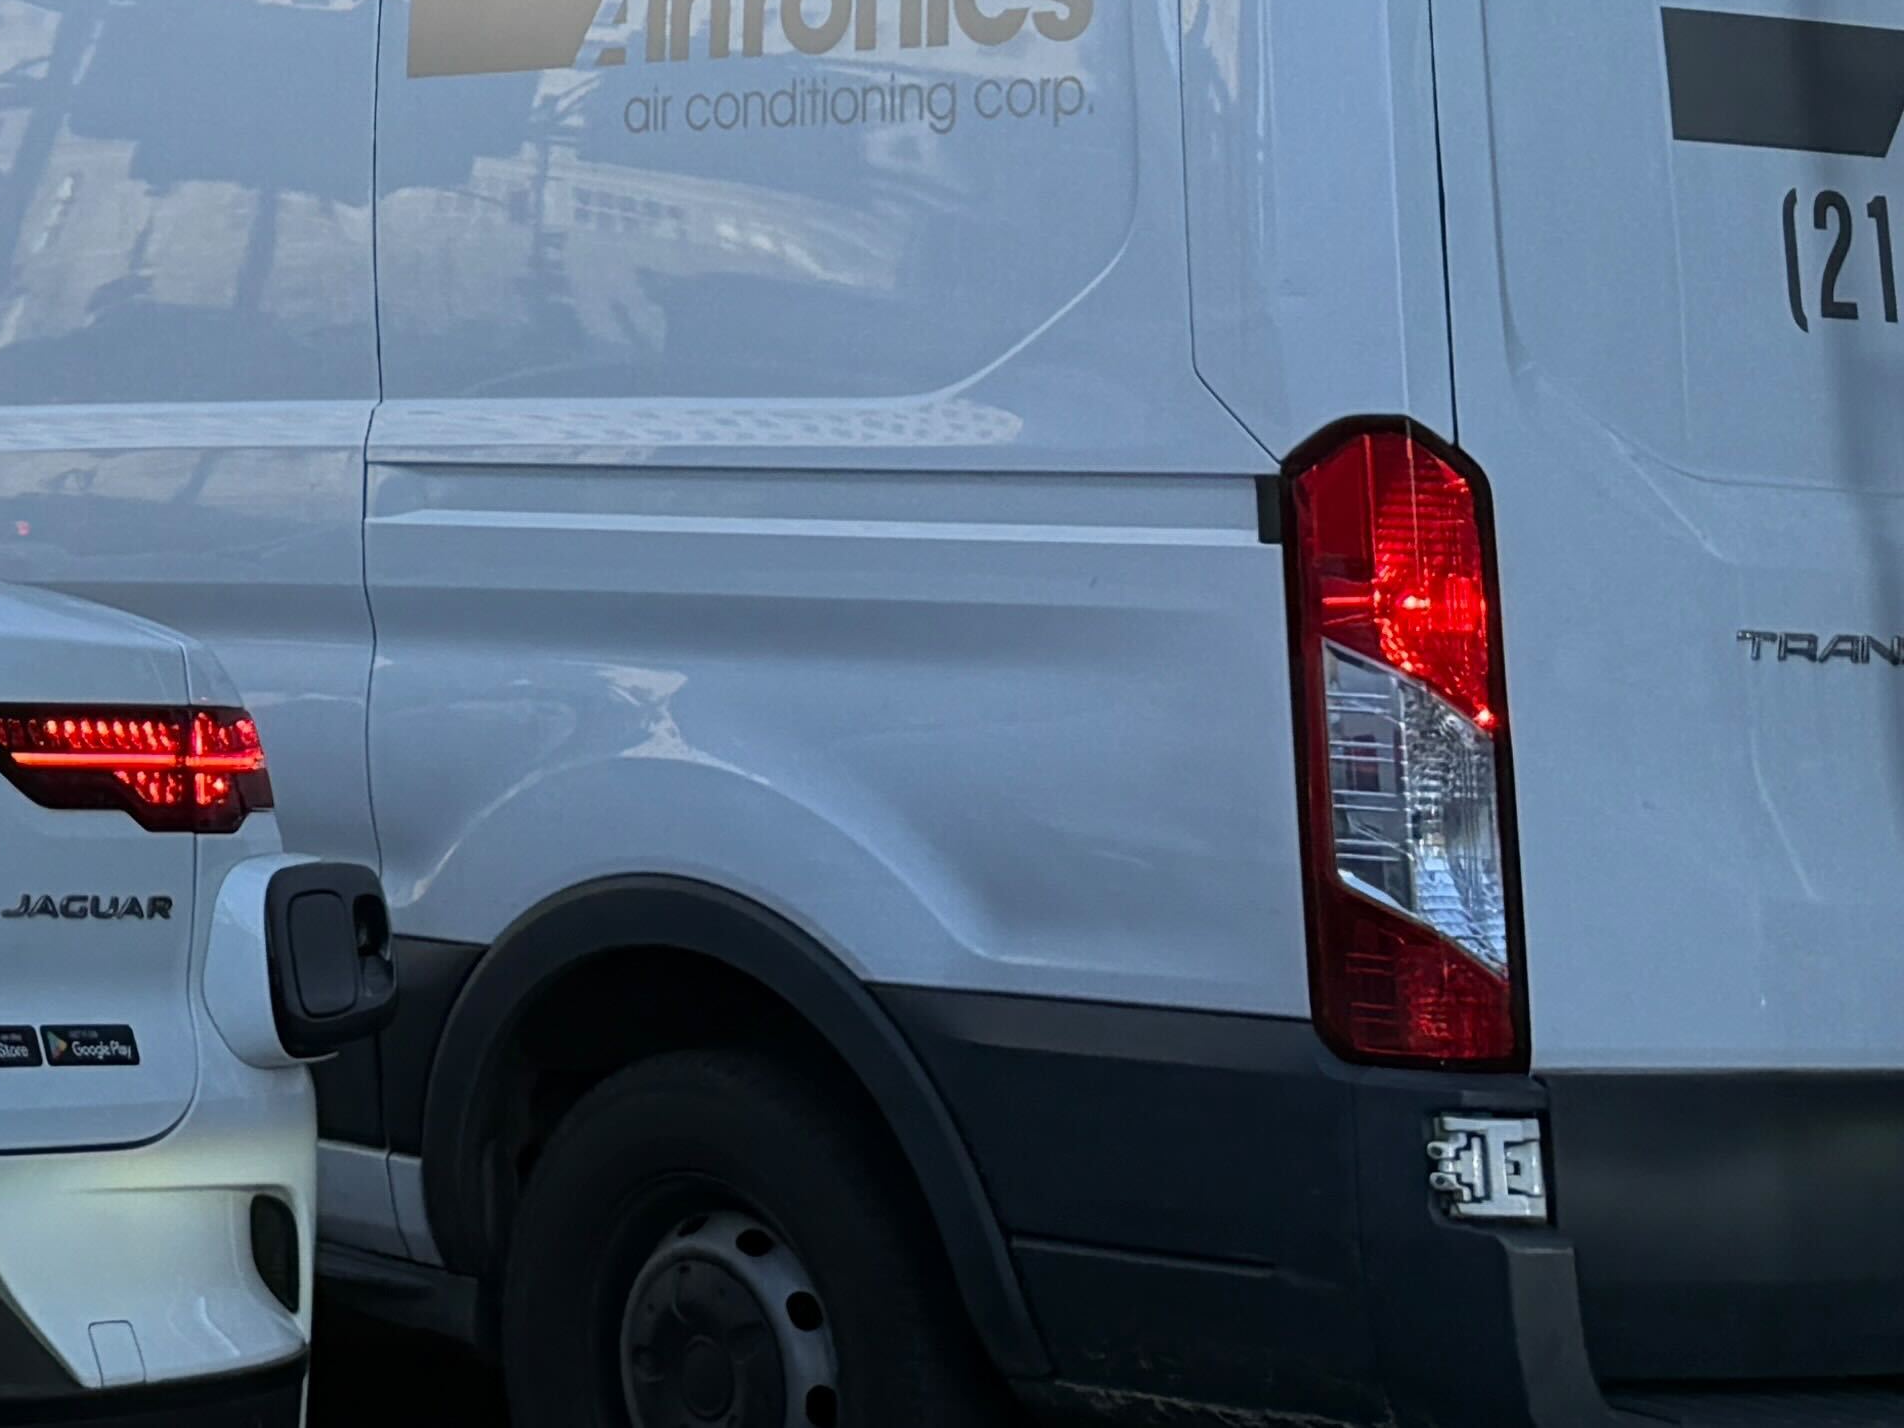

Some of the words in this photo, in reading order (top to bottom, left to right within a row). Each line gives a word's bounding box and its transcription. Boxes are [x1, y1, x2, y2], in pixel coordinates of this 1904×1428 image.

[623, 82, 672, 134] air
[685, 72, 956, 136] conditioning
[973, 73, 1095, 129] corp.
[1782, 188, 1898, 333] (21
[1736, 630, 1904, 666] TRAN
[0, 893, 174, 920] JAGUAR
[71, 1040, 110, 1060] Google
[110, 1040, 132, 1059] Play
